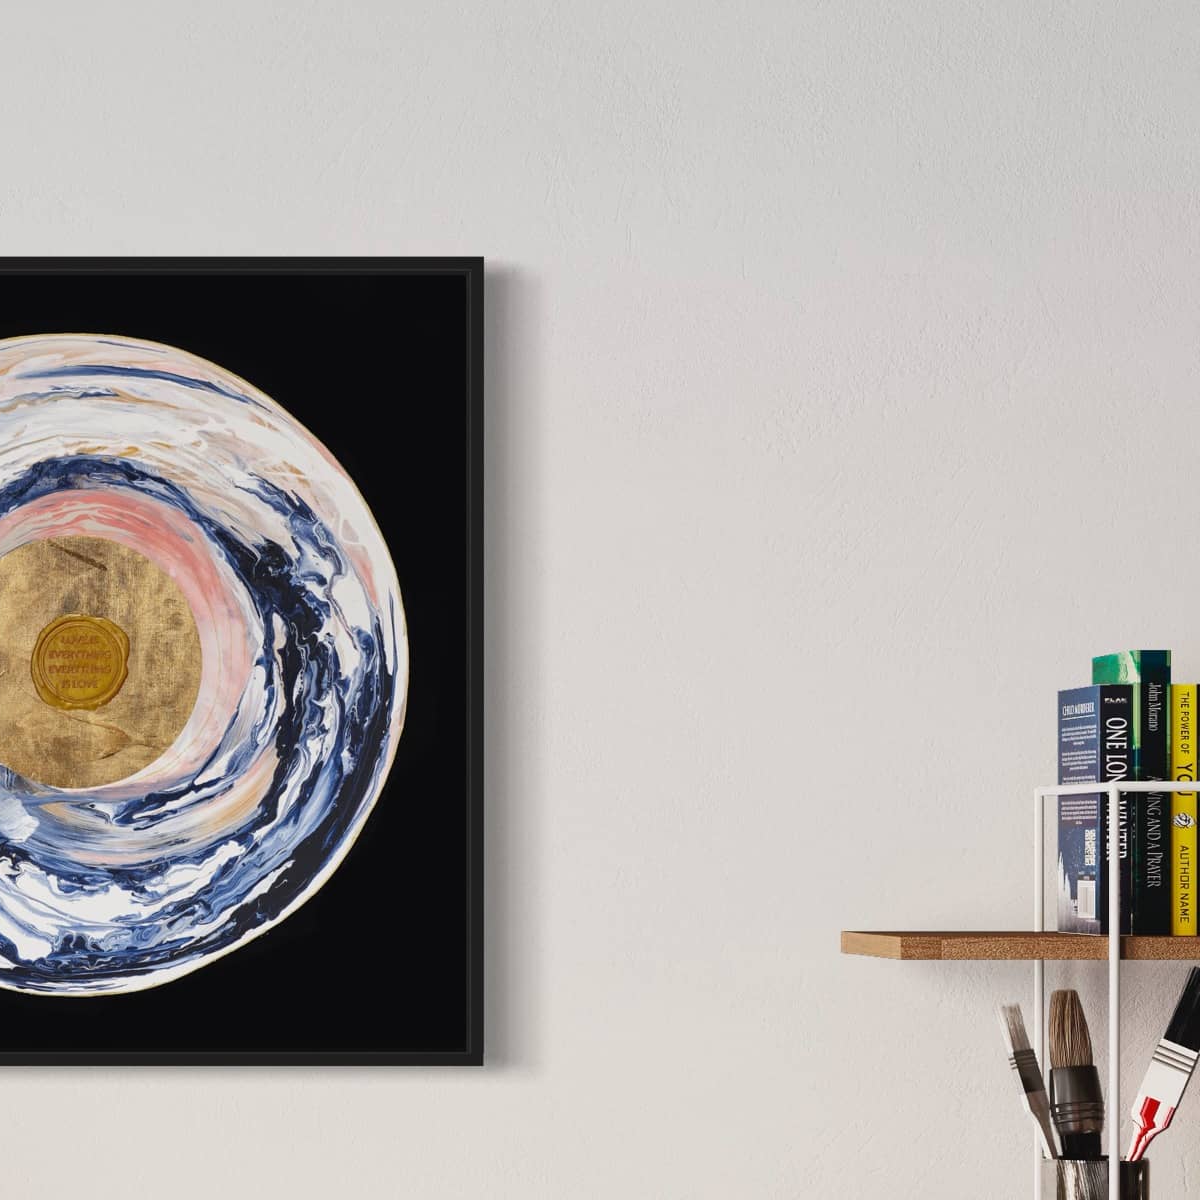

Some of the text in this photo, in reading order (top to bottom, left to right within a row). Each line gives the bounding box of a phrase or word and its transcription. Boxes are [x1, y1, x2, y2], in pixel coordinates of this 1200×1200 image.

[1148, 682, 1162, 732] John Morano
[1180, 691, 1190, 708] THE
[1105, 717, 1128, 749] ONE
[1180, 711, 1190, 741] POWER
[1180, 744, 1190, 754] OF
[1147, 817, 1161, 841] AND
[1147, 852, 1163, 888] PRAYER
[1180, 845, 1190, 923] AUTHOR NAME
